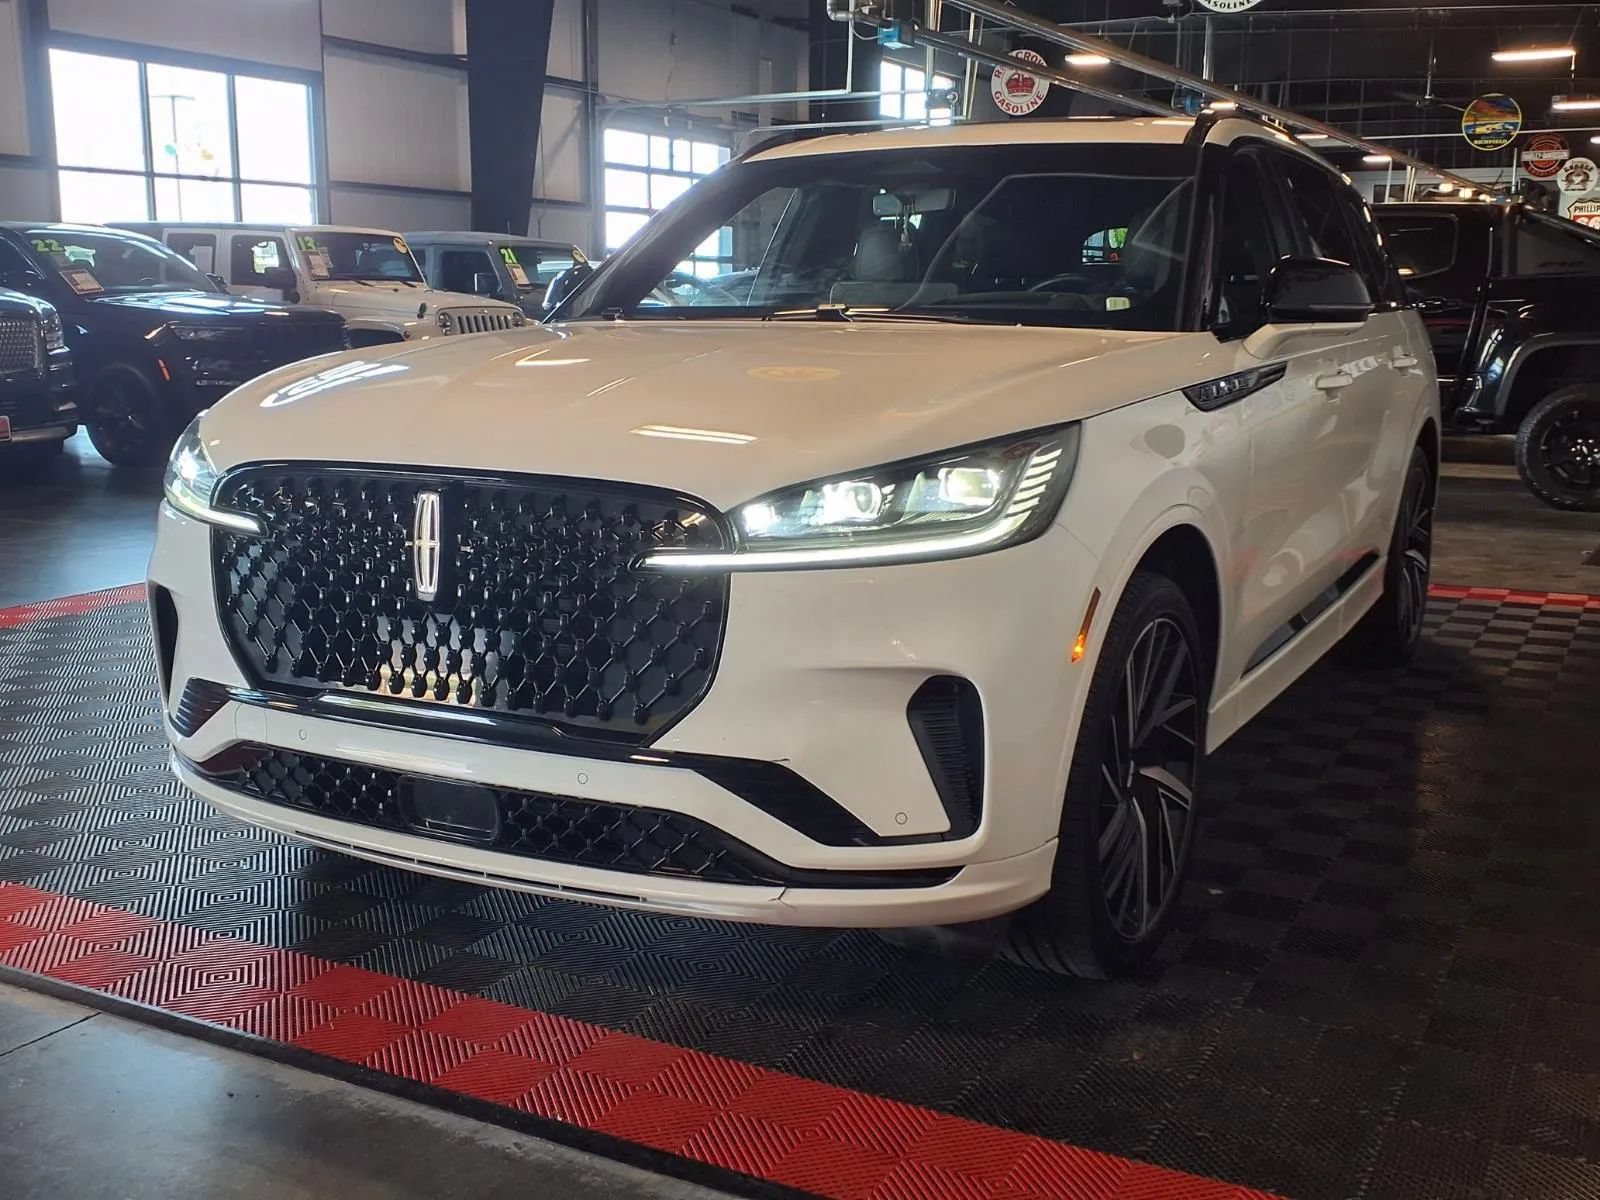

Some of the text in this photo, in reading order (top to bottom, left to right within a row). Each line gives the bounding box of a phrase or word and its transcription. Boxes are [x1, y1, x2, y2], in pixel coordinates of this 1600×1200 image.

[1205, 0, 1252, 9] SOLIN
[994, 90, 1045, 114] GASOLINE
[1574, 204, 1600, 213] PHILLIP
[31, 239, 64, 252] 22
[500, 248, 518, 264] 21
